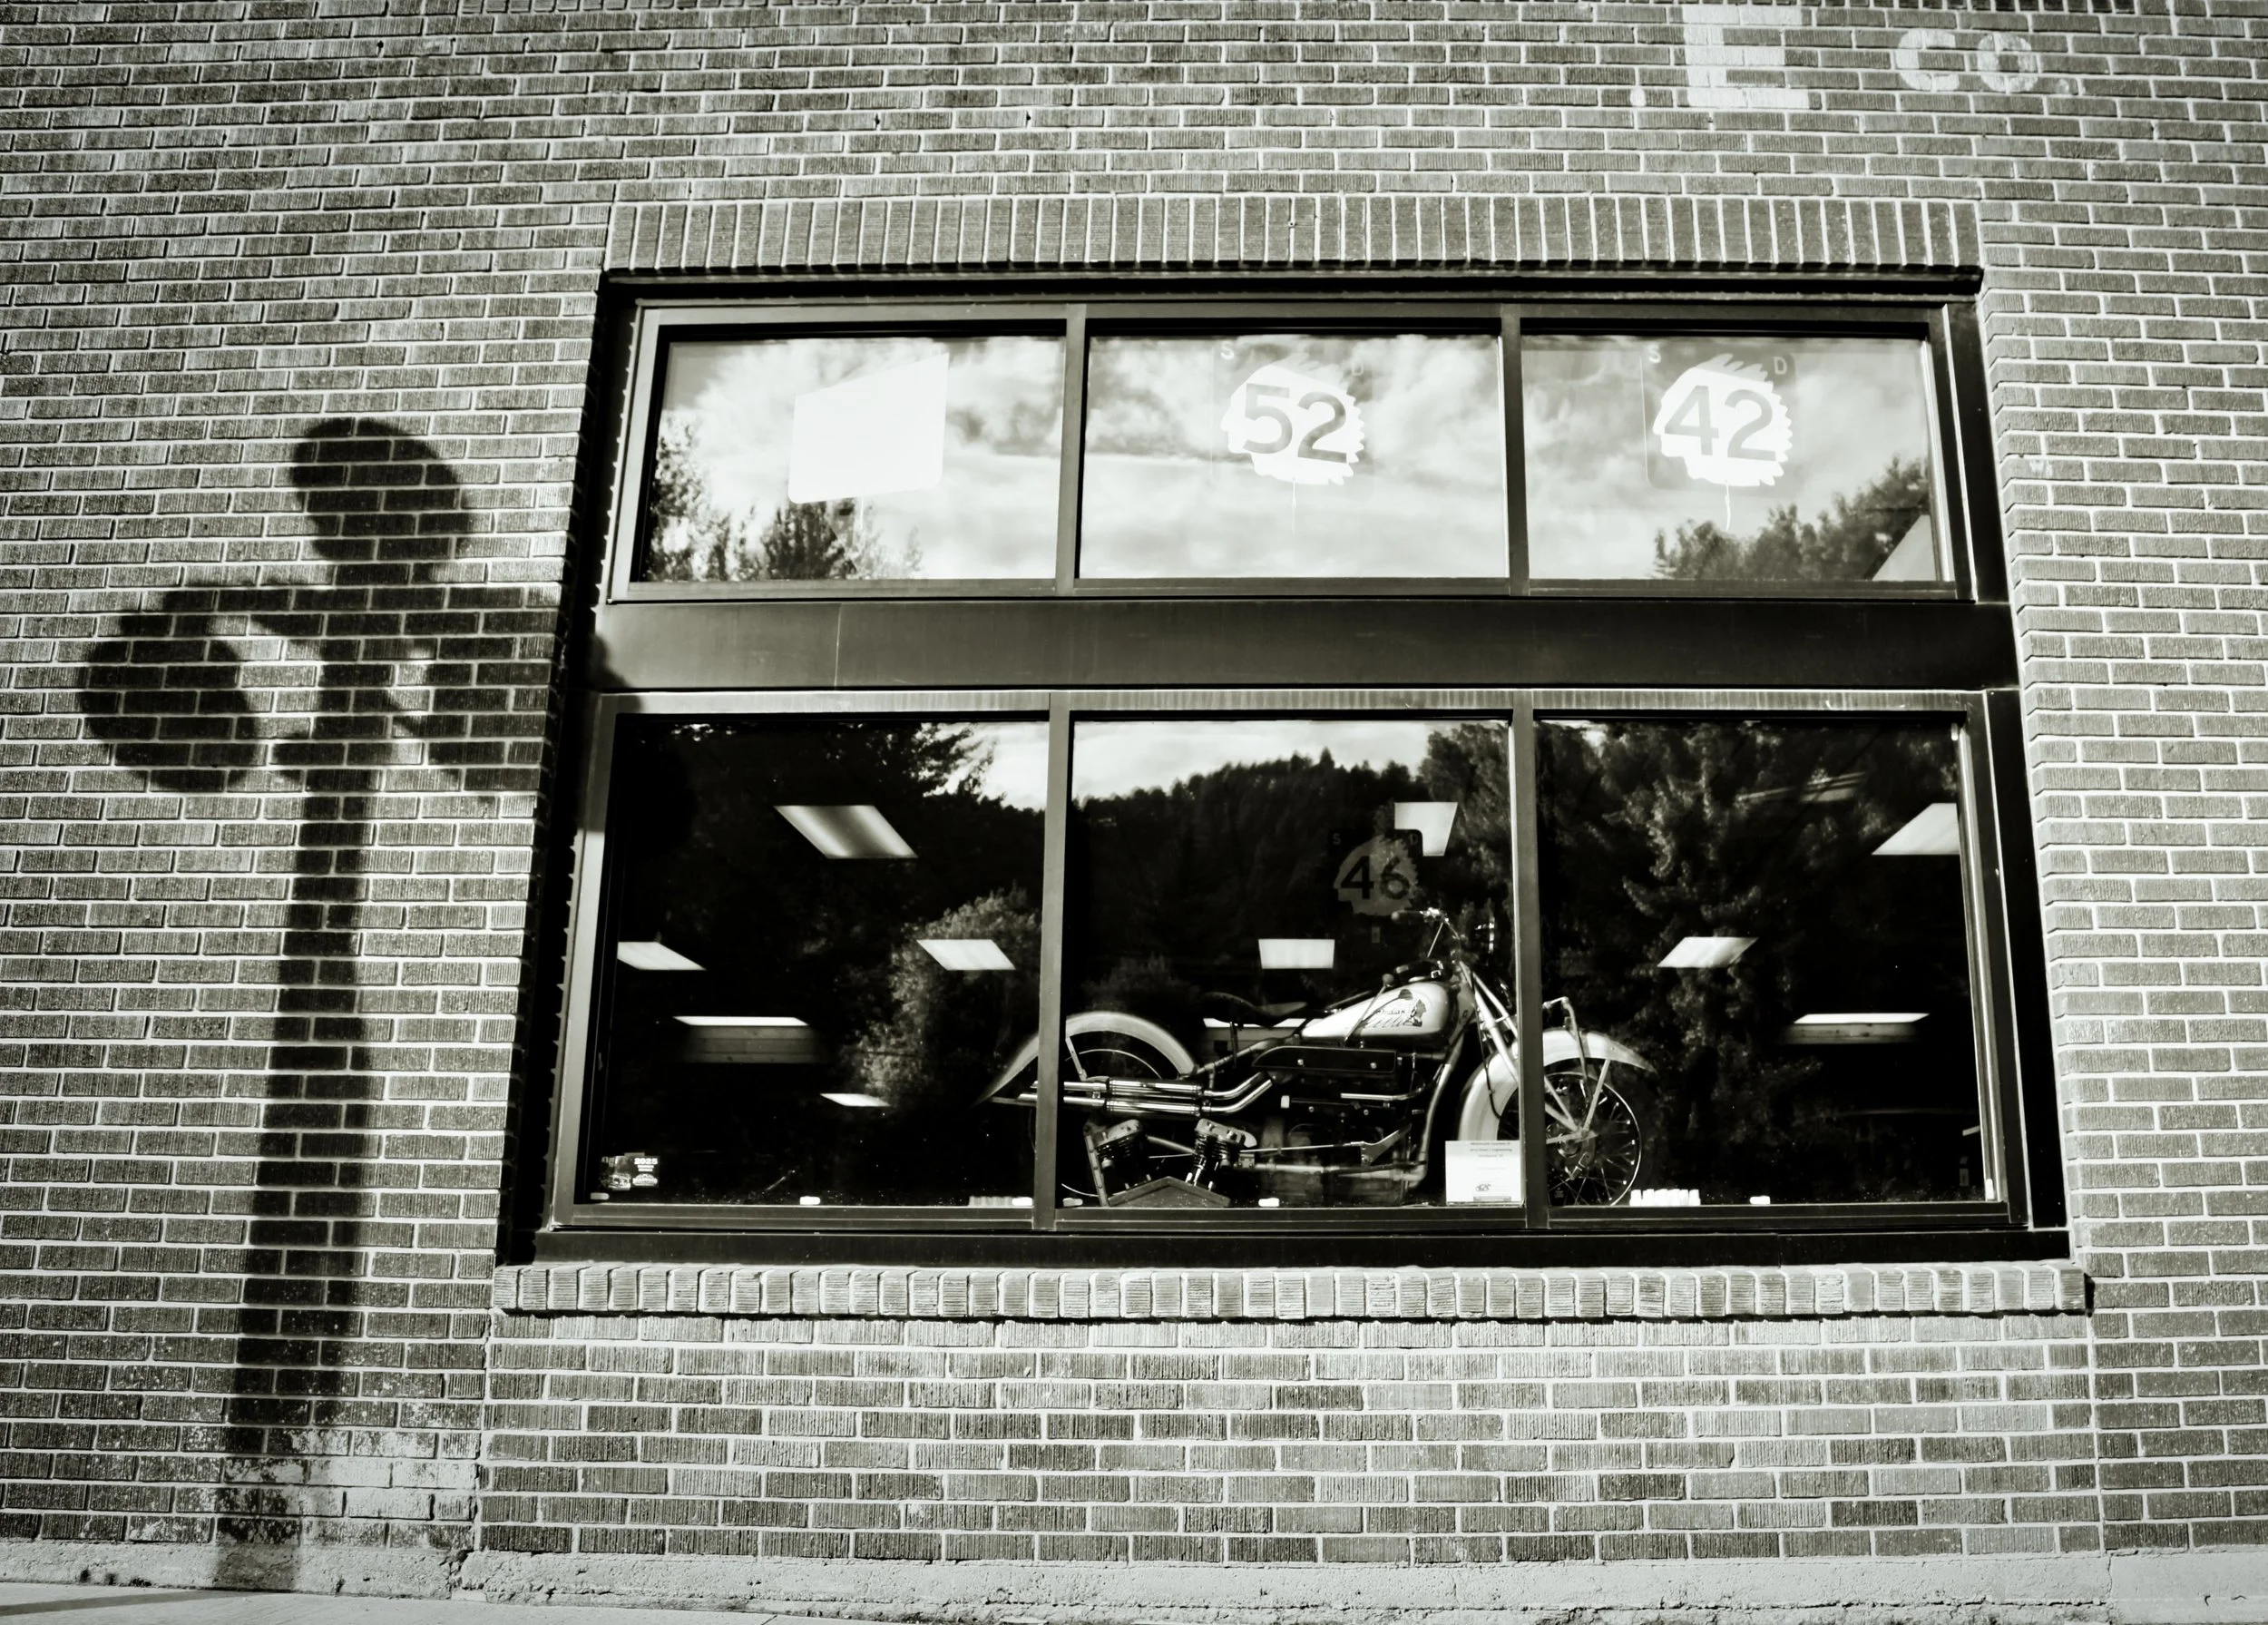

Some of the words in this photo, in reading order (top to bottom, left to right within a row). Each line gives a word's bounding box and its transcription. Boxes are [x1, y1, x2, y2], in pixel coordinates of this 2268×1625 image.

[1683, 5, 1810, 109] E
[1647, 344, 1662, 364] S
[1774, 356, 1788, 375] D
[1243, 383, 1347, 464] 52
[1664, 385, 1777, 462] 42
[1333, 834, 1341, 844] S
[1410, 834, 1418, 845] D
[1340, 856, 1410, 900] 46
